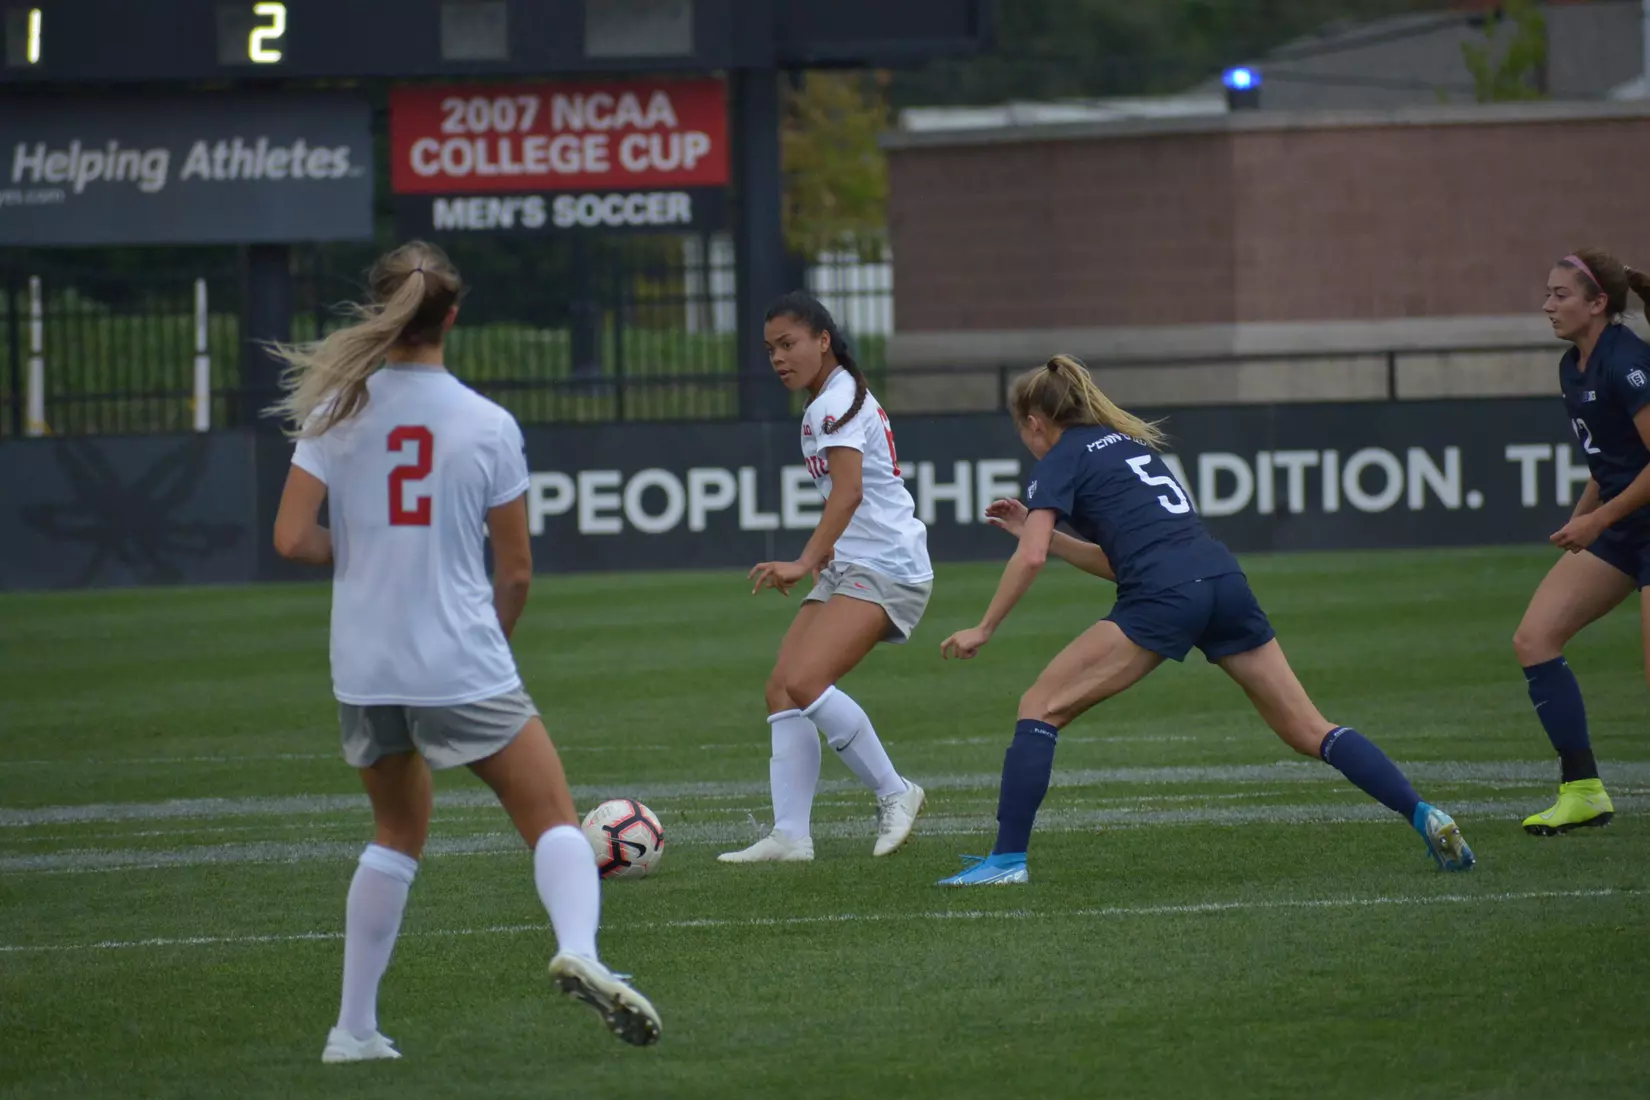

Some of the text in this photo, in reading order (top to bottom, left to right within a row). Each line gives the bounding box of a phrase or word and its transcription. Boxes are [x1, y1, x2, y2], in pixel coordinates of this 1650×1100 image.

[249, 2, 287, 63] 2
[441, 89, 677, 134] 2007 NCAA
[11, 140, 170, 193] Helping
[410, 132, 711, 177] COLLEGE CUP
[432, 192, 692, 230] MEN'S SOCCER
[387, 425, 434, 527] 2
[528, 466, 824, 536] PEOPLE
[1125, 454, 1190, 514] 5
